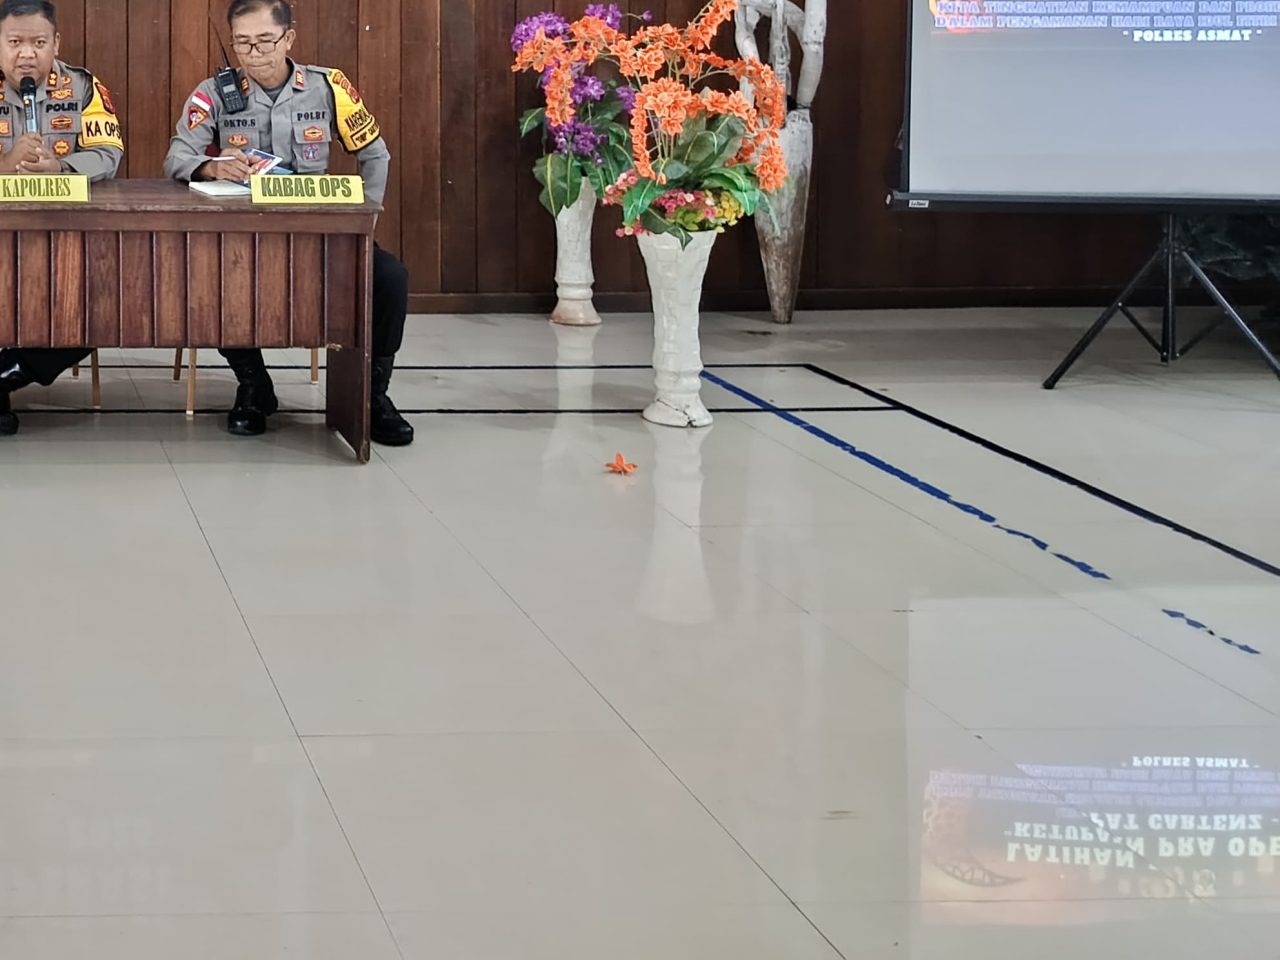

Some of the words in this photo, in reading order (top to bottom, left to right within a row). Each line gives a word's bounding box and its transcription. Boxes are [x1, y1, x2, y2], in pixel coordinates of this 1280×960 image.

[1132, 29, 1193, 42] POLRES
[1196, 29, 1253, 41] ASMAT
[45, 101, 78, 113] POLRI
[85, 120, 102, 138] KA
[2, 177, 72, 198] KAPOLRES
[260, 176, 317, 198] KABAG
[318, 176, 352, 198] OPS
